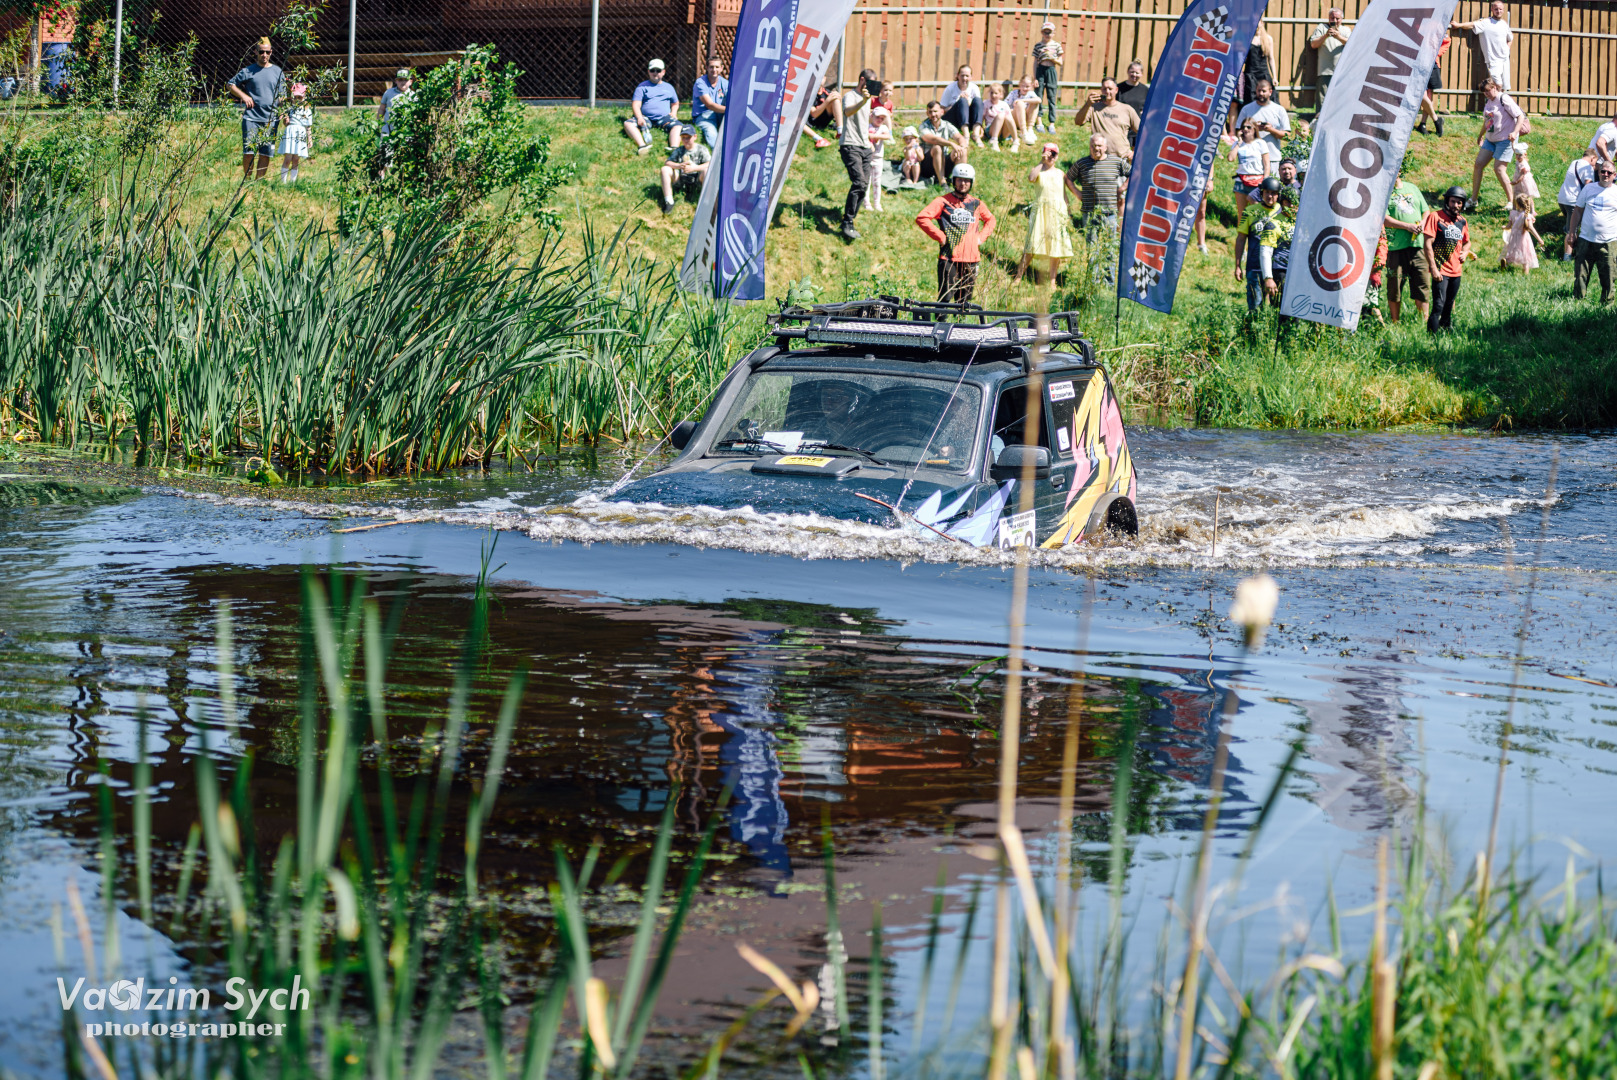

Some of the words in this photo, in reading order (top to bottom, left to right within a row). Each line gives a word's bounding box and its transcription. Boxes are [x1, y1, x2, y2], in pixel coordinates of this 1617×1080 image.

[733, 0, 783, 194] SVT.B
[1134, 25, 1232, 273] AUTORUL.BY
[1174, 204, 1197, 244] ПРО
[1189, 73, 1238, 203] АВТОМОБИЛИ
[1328, 8, 1435, 219] COMMA
[1311, 302, 1358, 322] SVIAT
